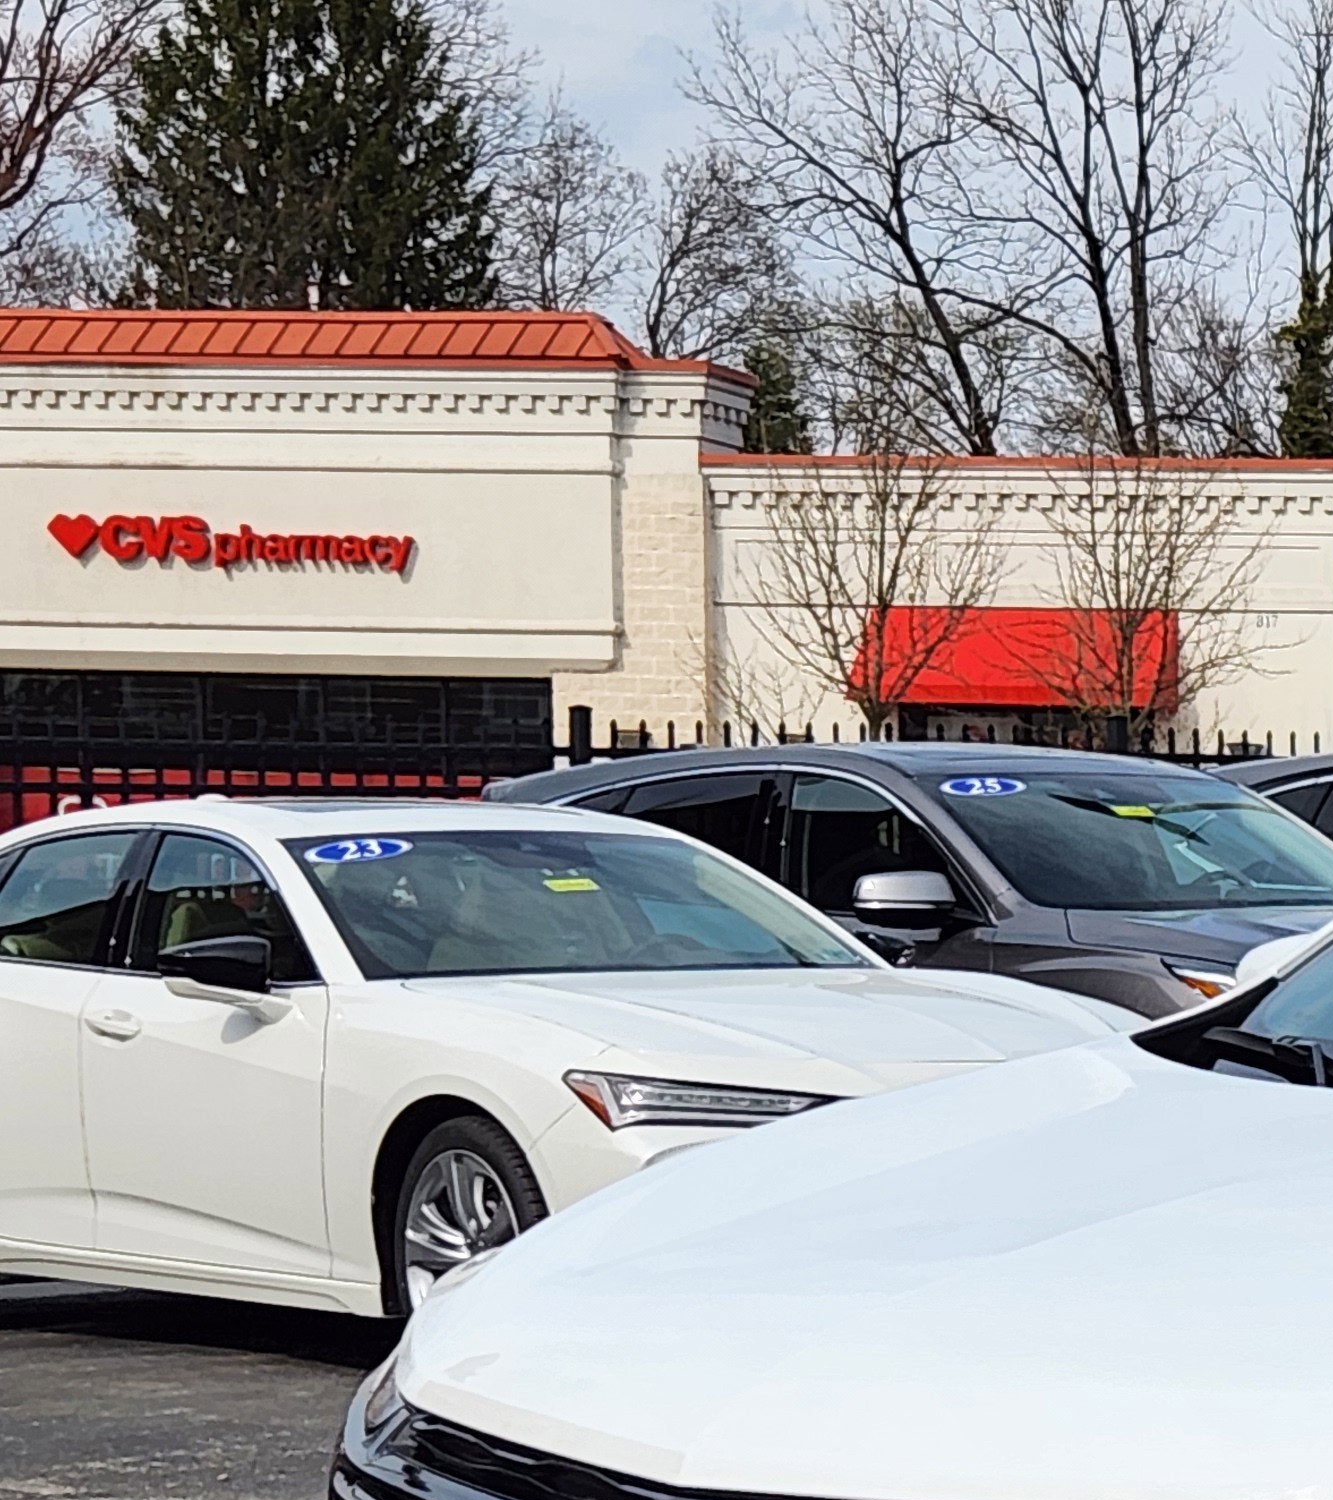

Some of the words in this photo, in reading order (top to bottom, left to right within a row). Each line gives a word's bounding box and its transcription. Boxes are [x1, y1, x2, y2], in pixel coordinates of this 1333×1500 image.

[100, 514, 211, 560] CVS
[214, 524, 415, 573] pharmacy
[964, 777, 1002, 794] 25
[337, 838, 383, 861] 23
